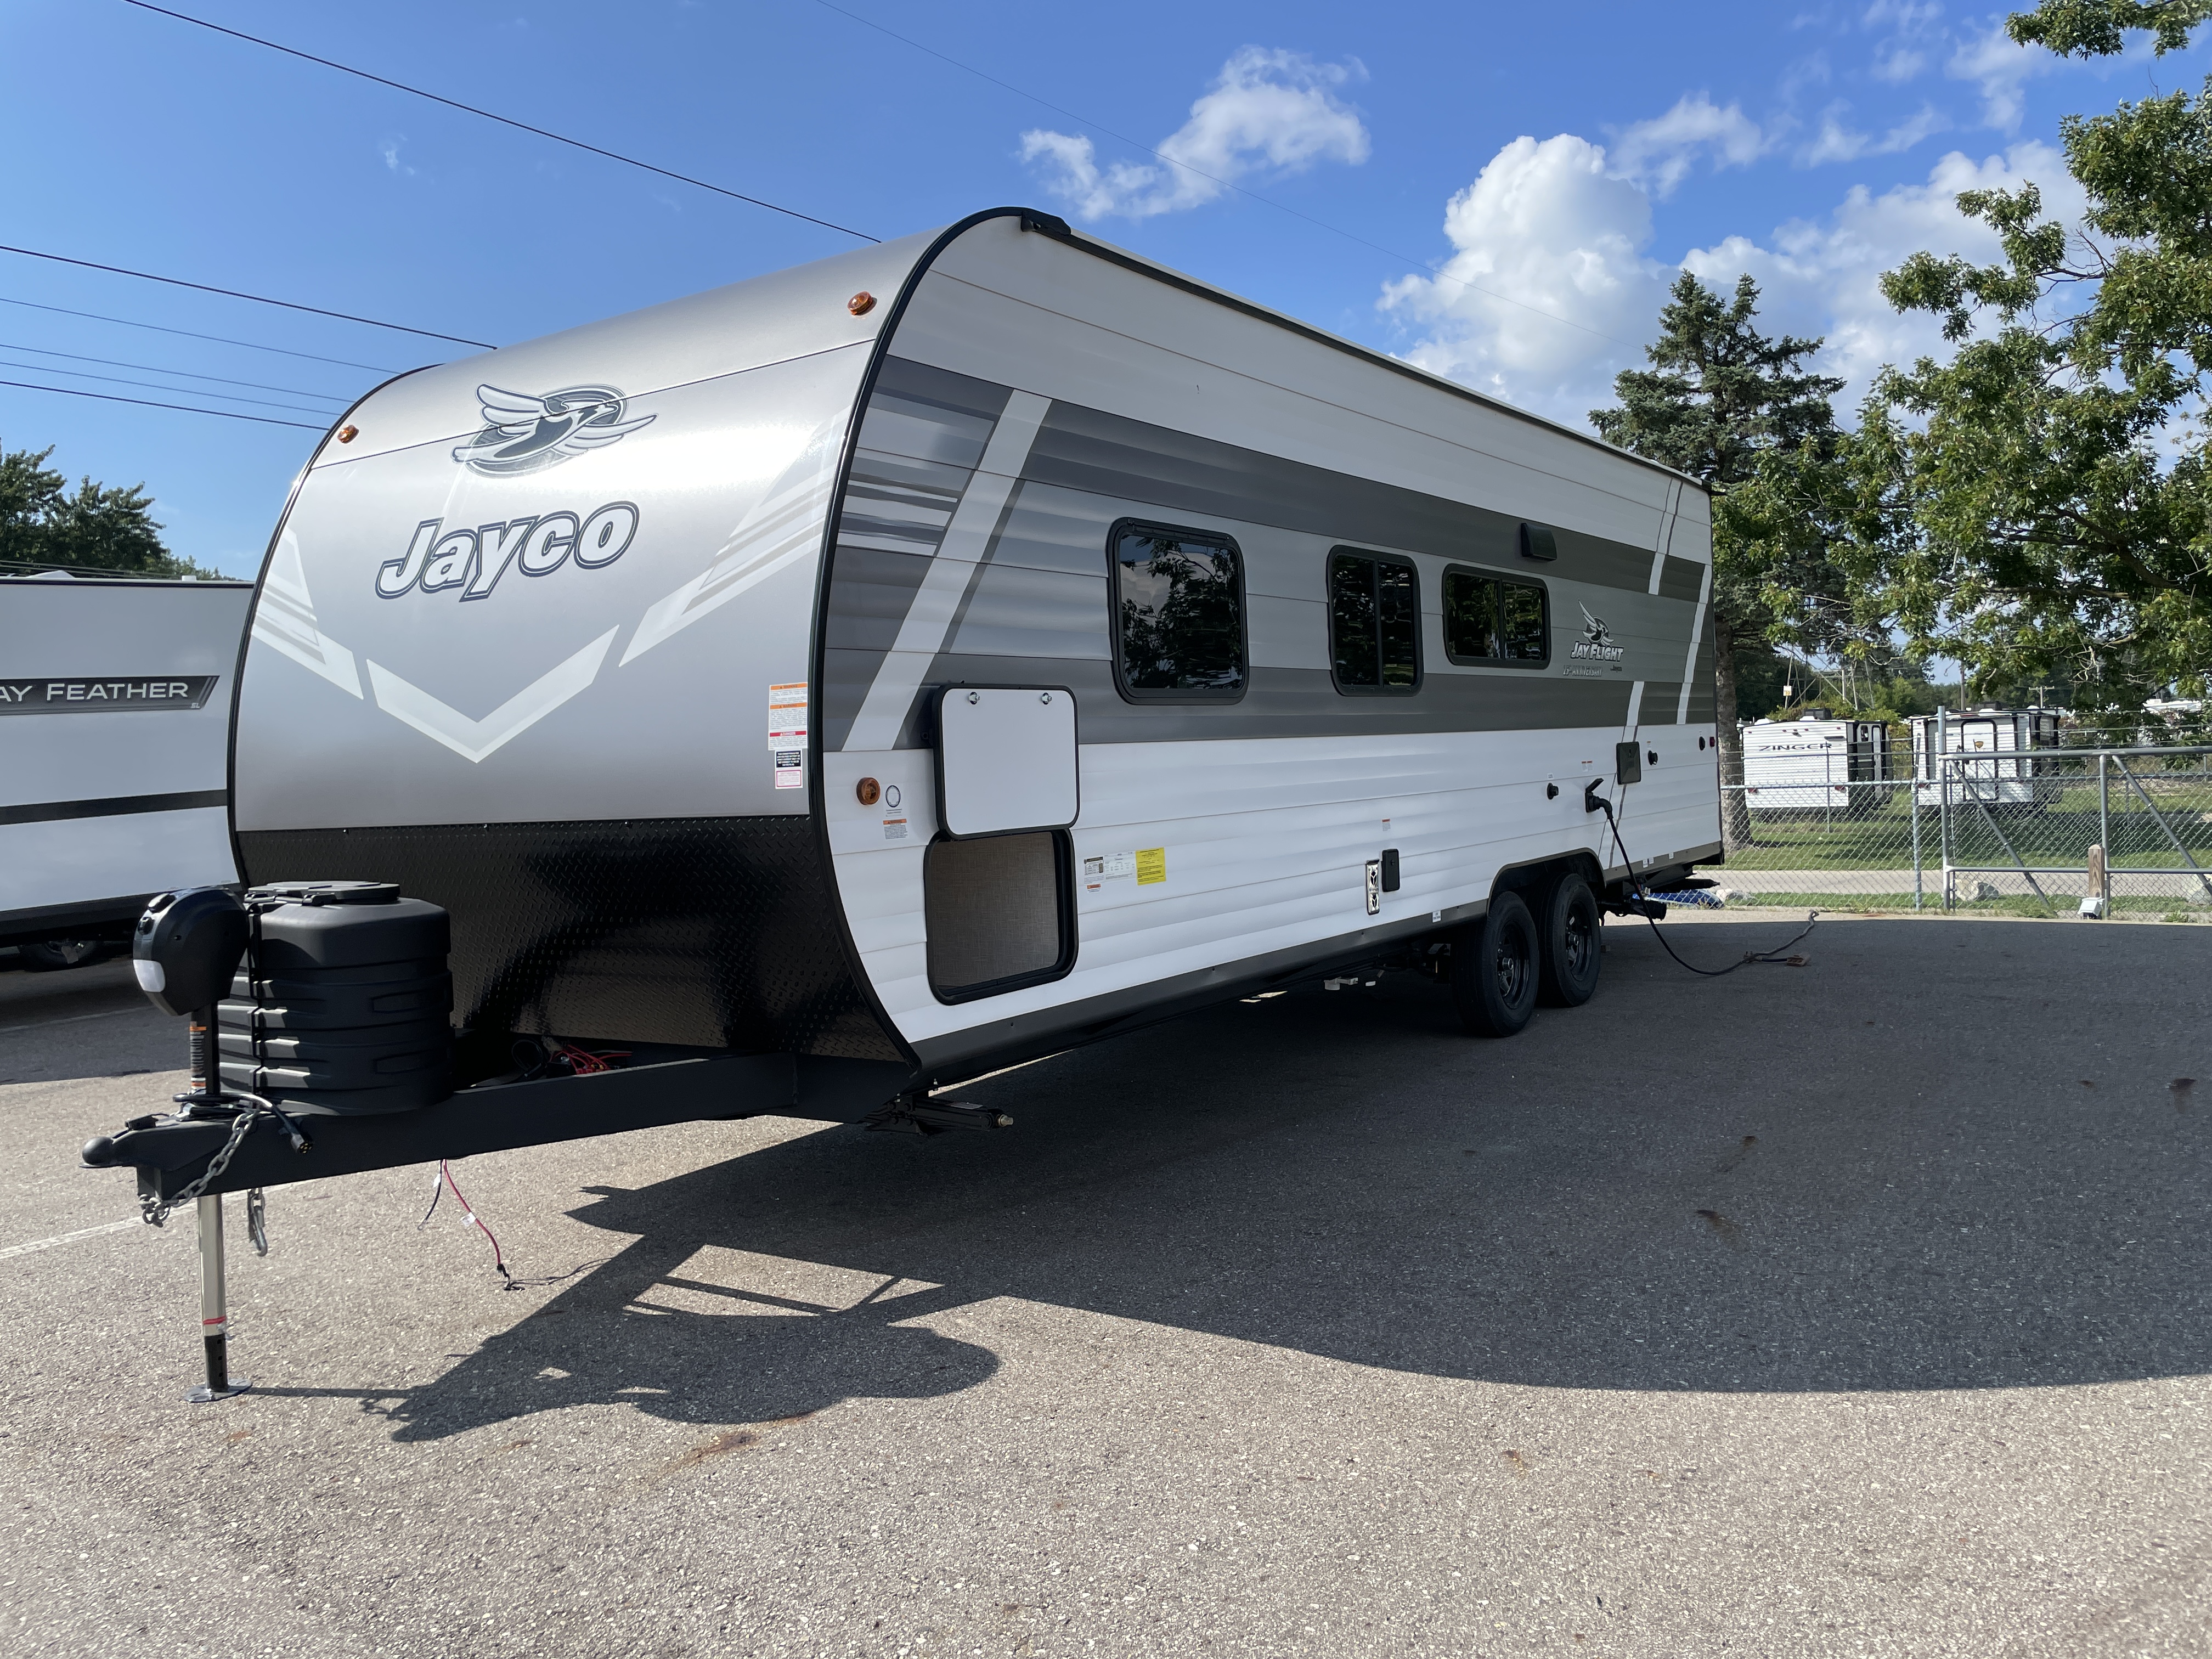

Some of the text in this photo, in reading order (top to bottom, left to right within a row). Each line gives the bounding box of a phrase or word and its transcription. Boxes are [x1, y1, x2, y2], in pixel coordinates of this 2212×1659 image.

[375, 500, 640, 602] Jayco
[1571, 641, 1624, 662] JAY FLIGHT
[46, 682, 188, 701] FEATHER
